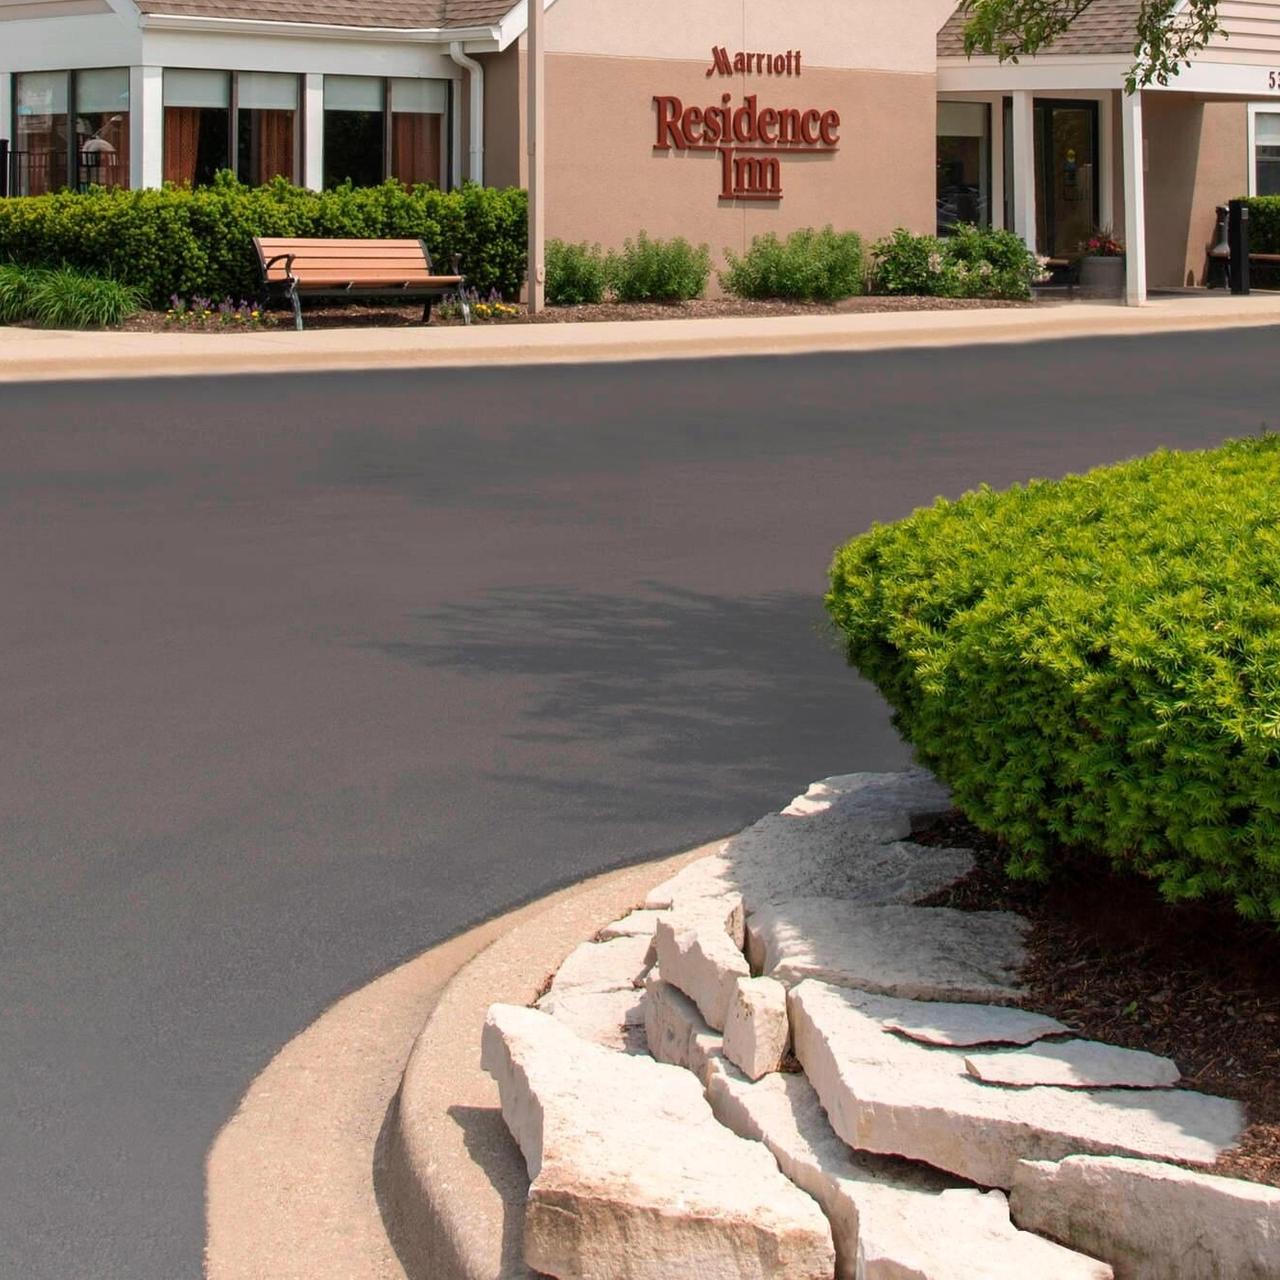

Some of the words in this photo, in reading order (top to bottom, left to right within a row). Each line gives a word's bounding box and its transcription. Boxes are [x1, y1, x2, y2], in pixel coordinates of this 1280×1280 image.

[705, 45, 801, 77] Marriott
[652, 93, 841, 150] Residence
[718, 147, 783, 200] Inn
